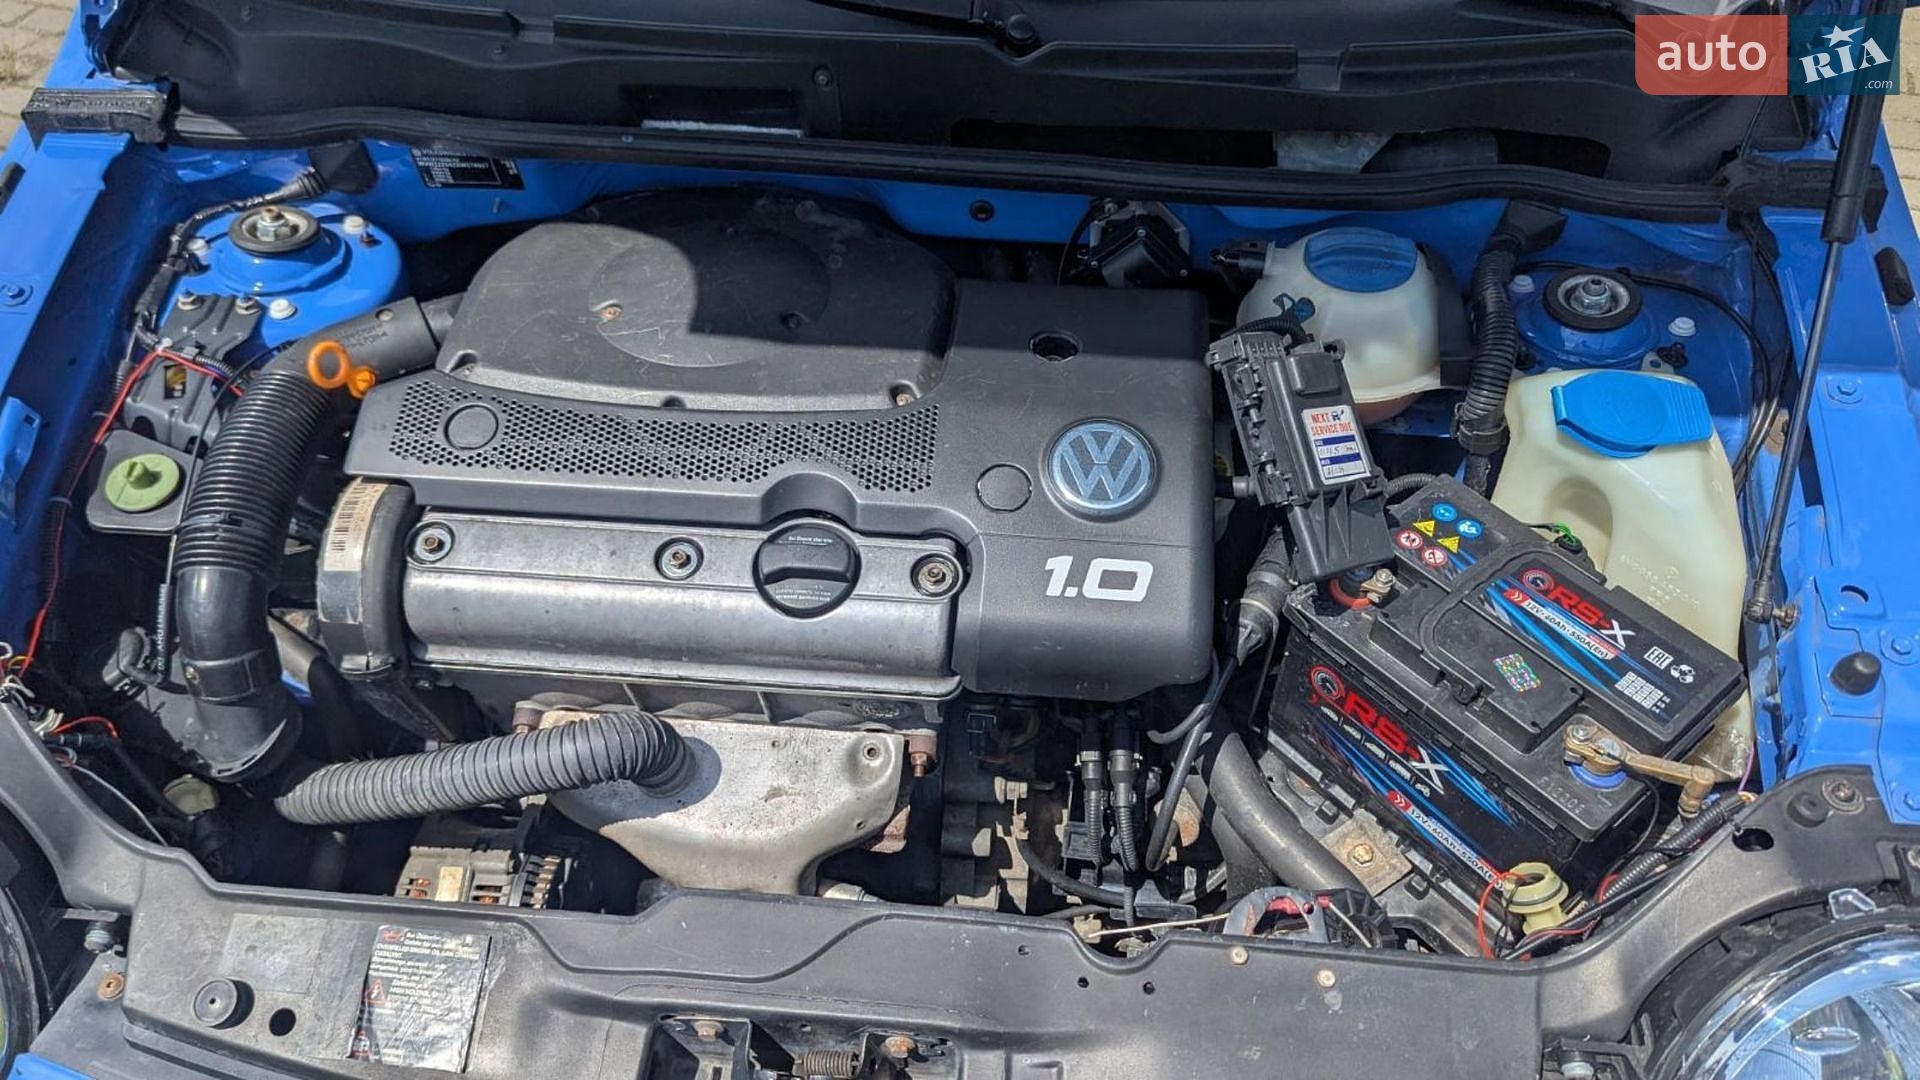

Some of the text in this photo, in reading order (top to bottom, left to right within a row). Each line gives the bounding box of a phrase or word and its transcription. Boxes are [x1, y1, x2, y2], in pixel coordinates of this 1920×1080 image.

[1311, 412, 1329, 423] NEXT
[1312, 424, 1338, 435] SERVICE
[1045, 555, 1153, 602] 1.0
